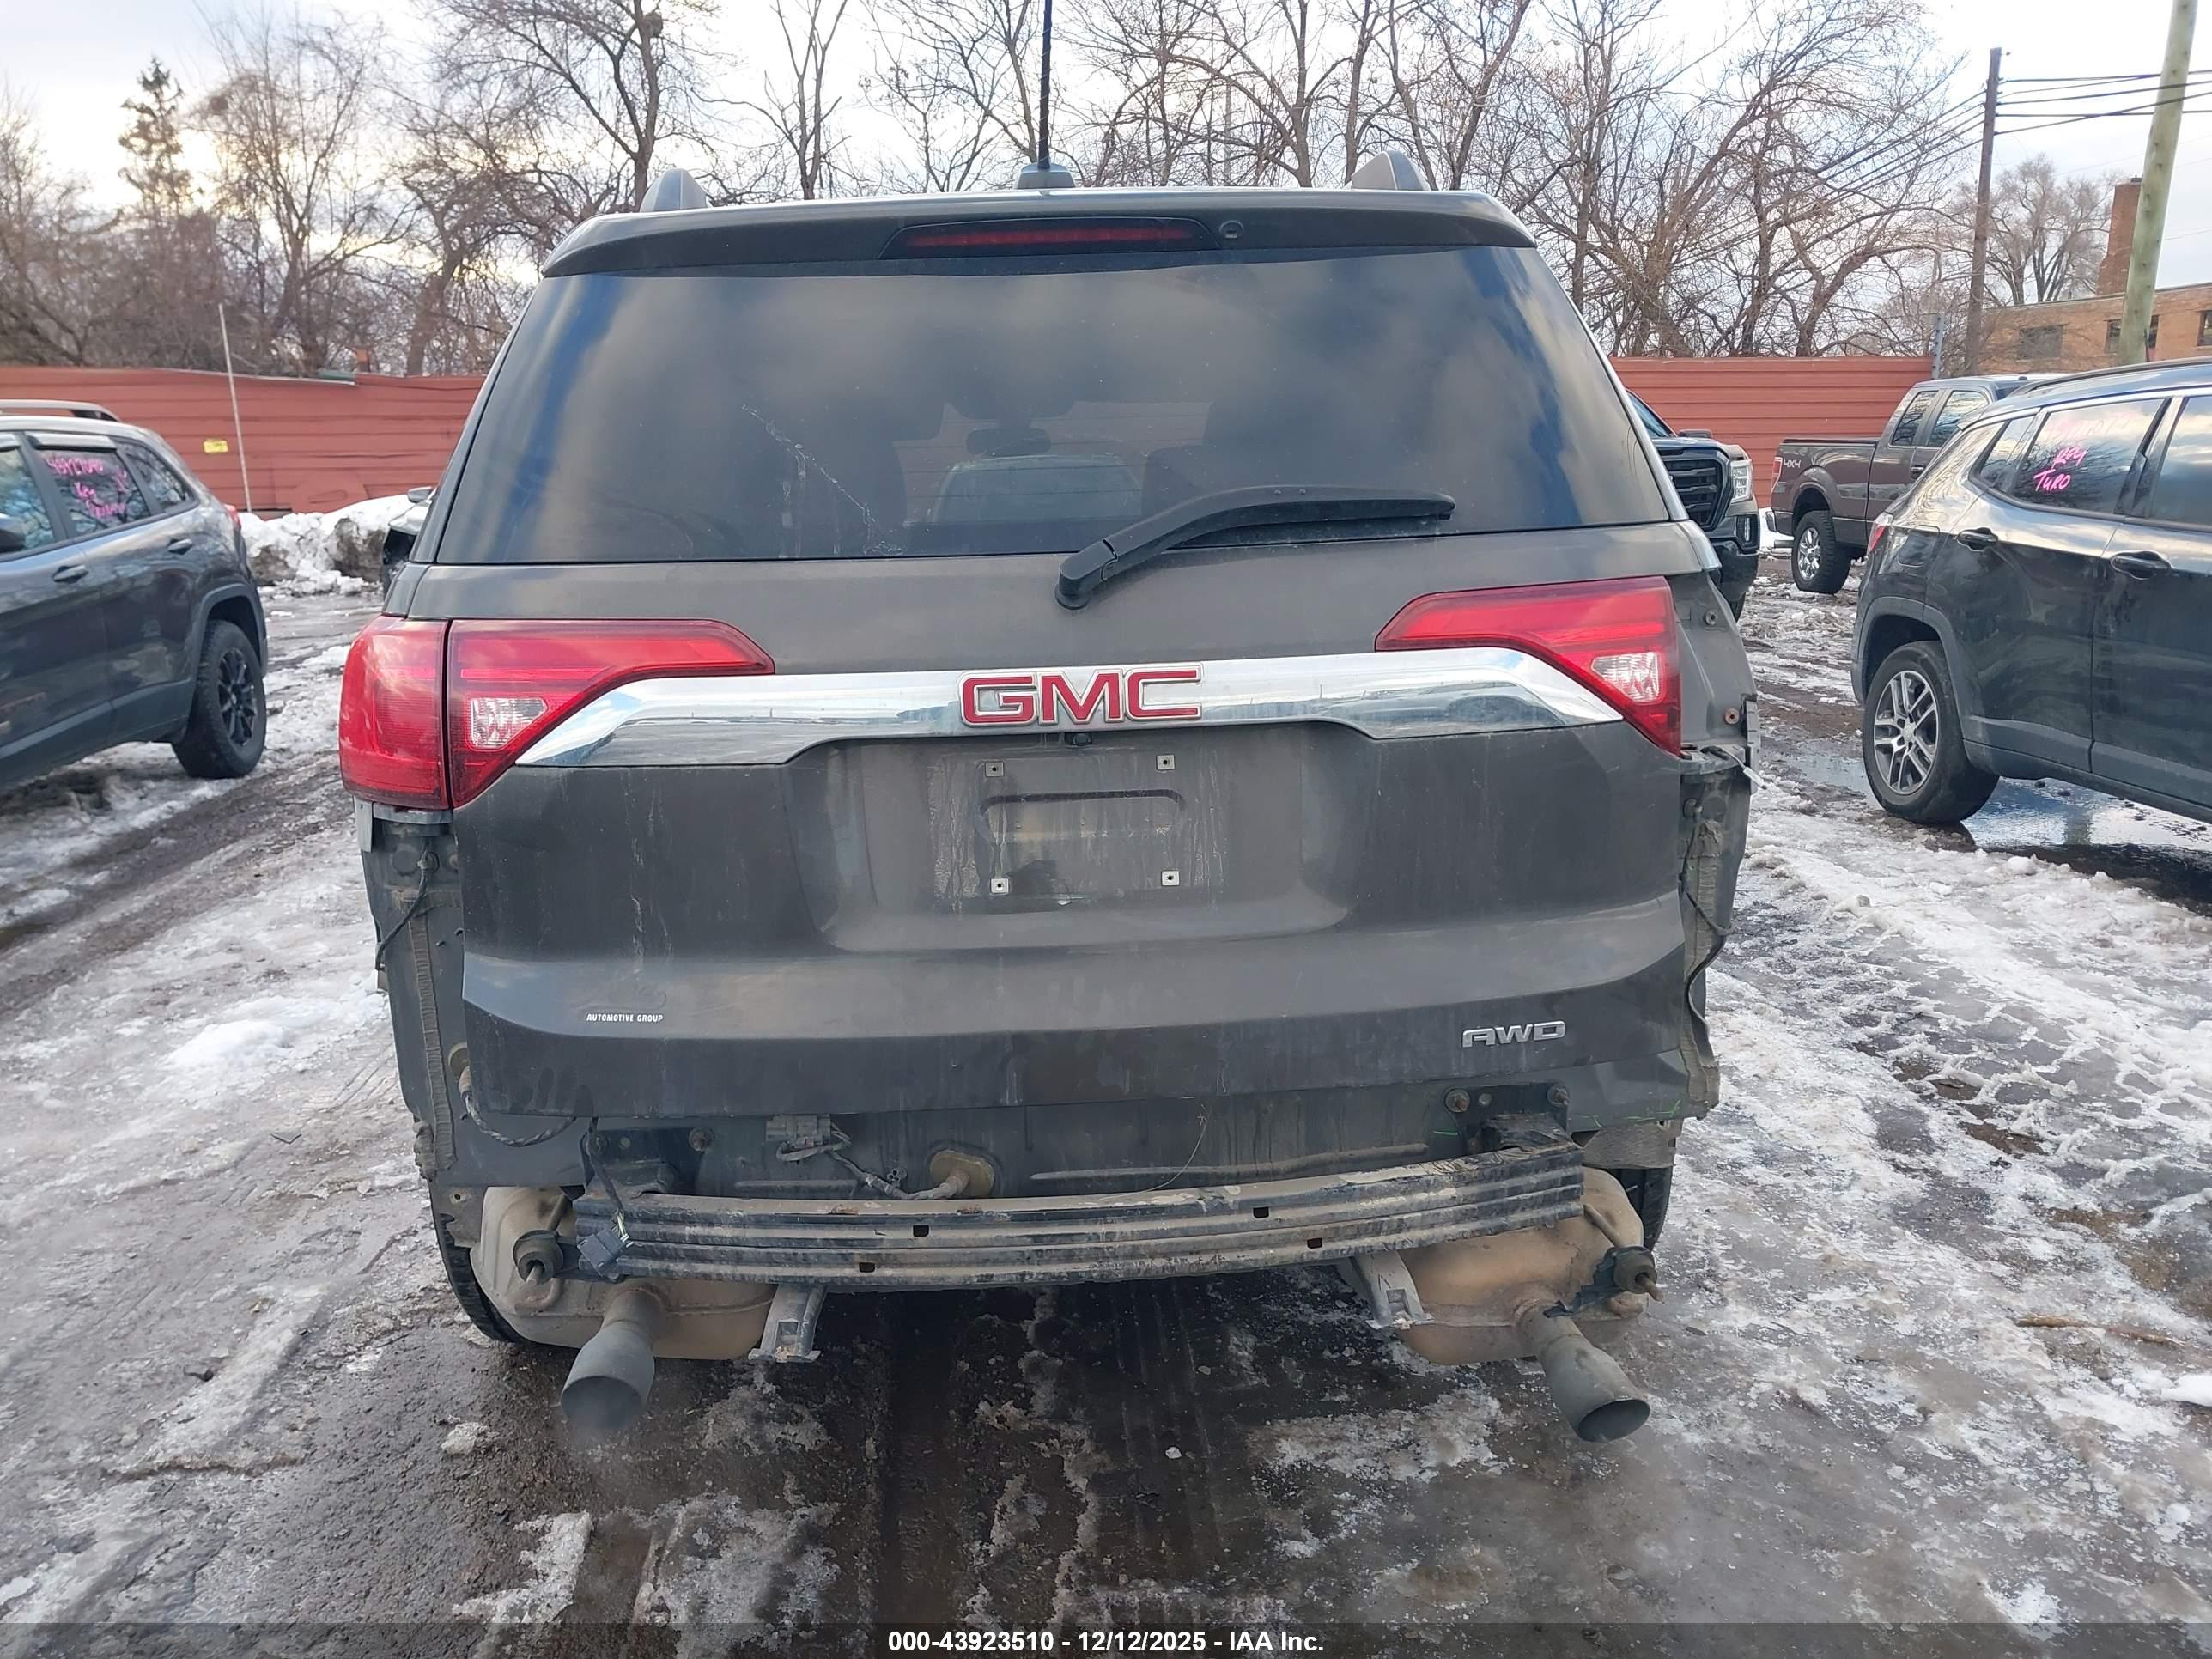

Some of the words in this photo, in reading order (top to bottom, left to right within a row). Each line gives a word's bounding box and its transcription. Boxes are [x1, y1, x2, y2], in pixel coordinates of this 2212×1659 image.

[959, 664, 1202, 726] GMC
[586, 1013, 635, 1023] AUTOMOTIVE
[636, 1014, 664, 1023] GROUP
[1462, 1020, 1566, 1048] AWD
